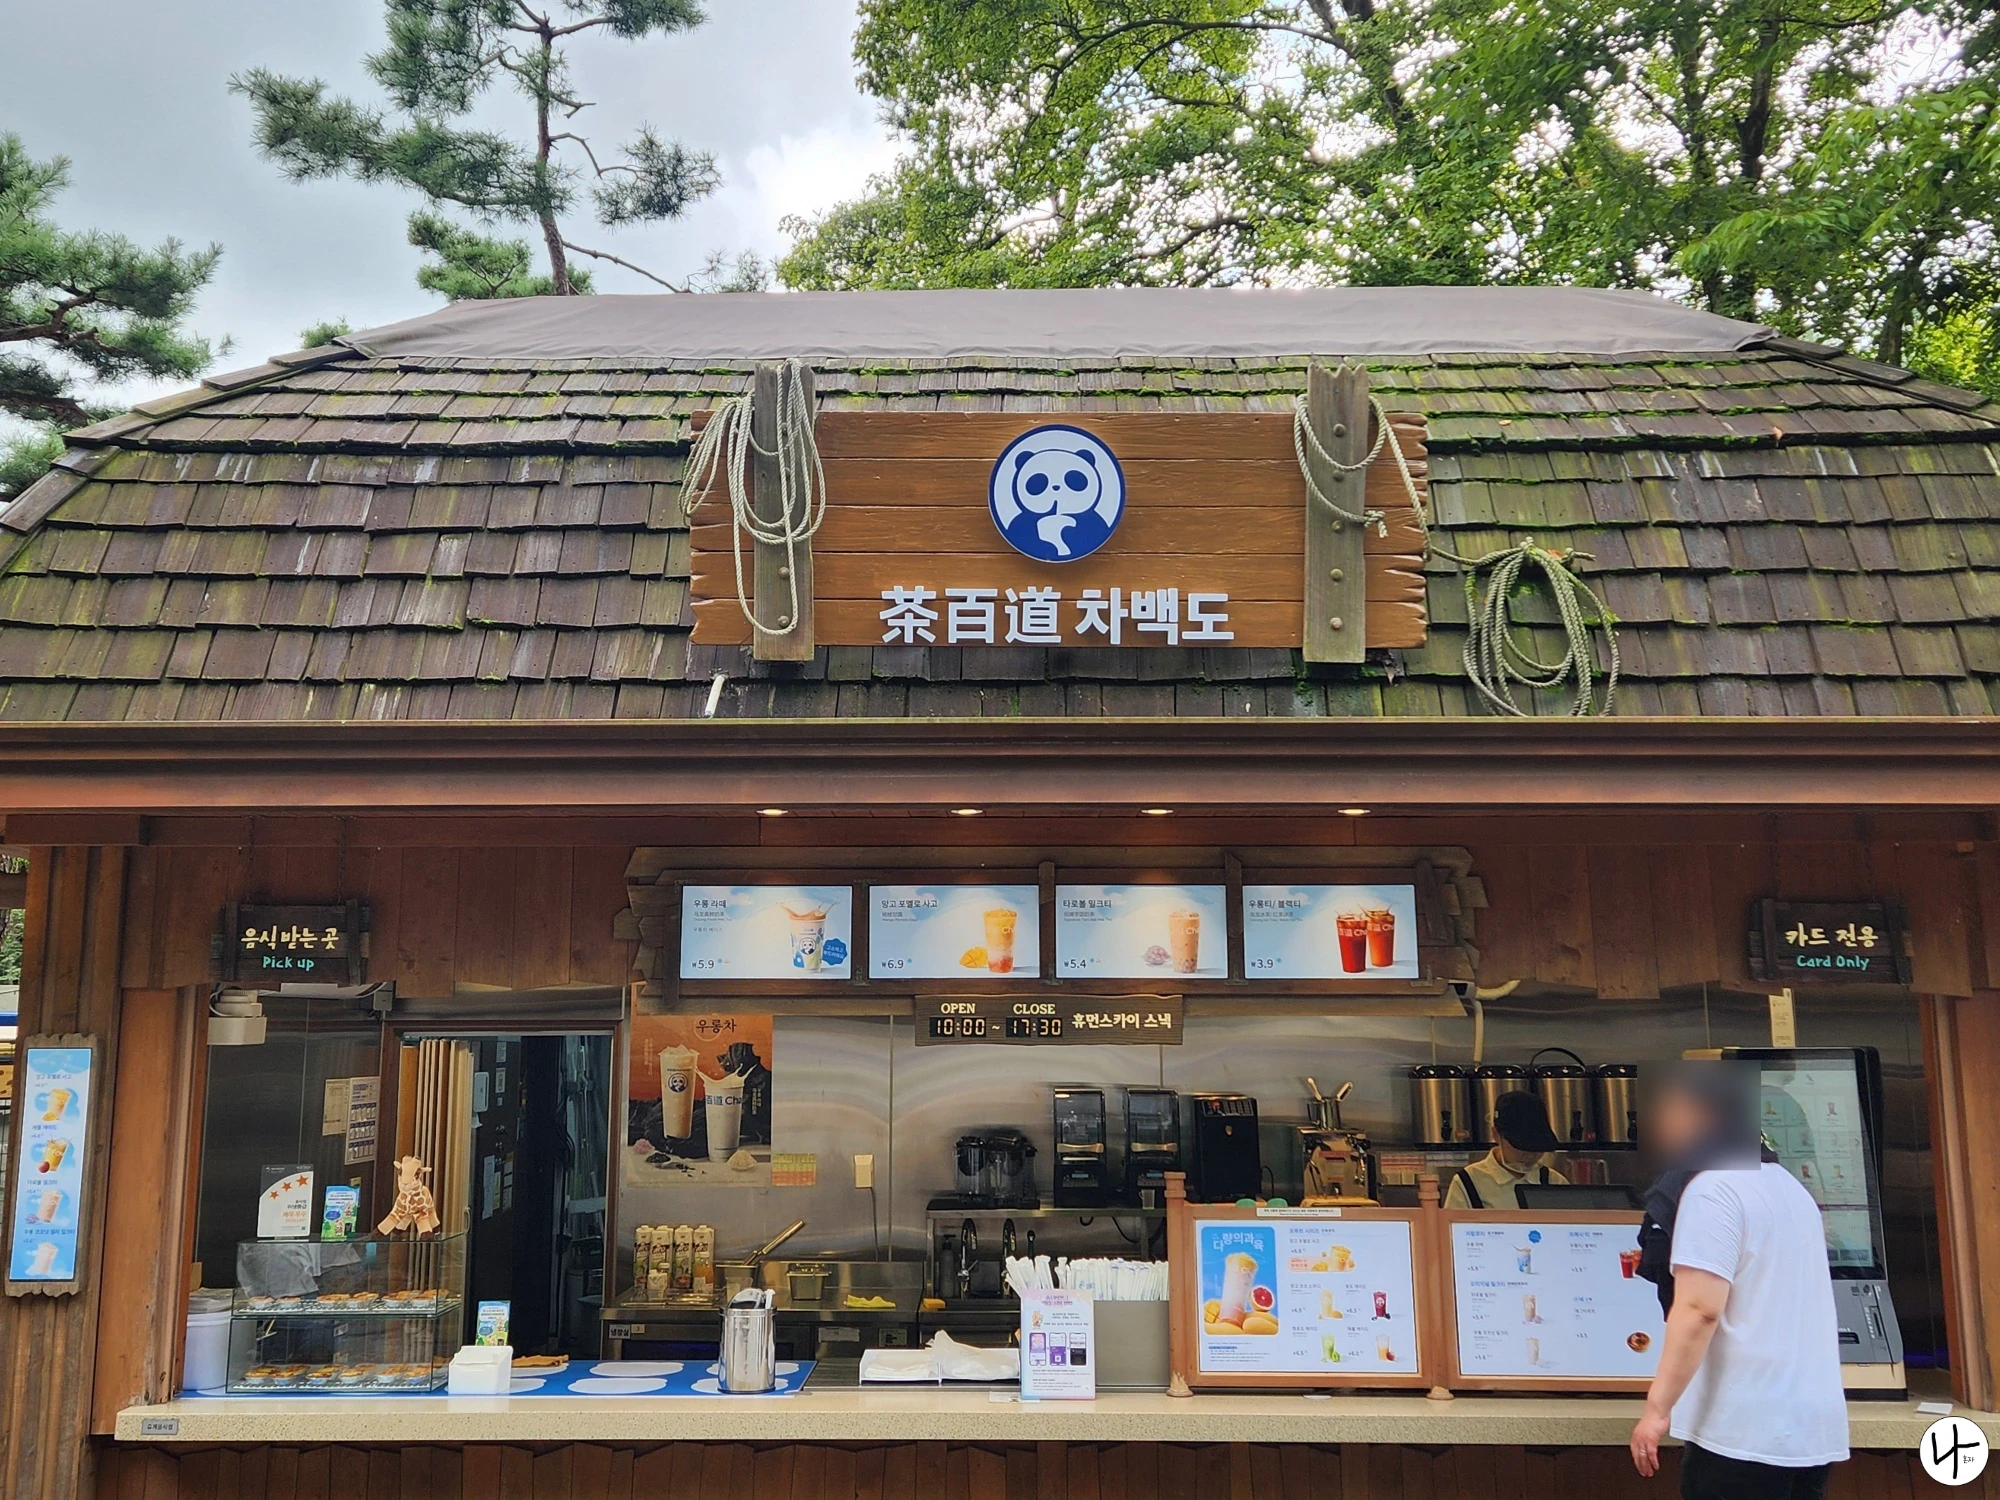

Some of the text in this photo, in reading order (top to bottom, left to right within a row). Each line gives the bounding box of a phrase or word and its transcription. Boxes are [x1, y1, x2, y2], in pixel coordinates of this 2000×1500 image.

[880, 585, 1235, 646] 茶百道 차백도
[923, 900, 938, 908] 사고
[241, 925, 339, 950] 음식 받는 곳
[1785, 922, 1878, 948] 카드 전용
[263, 956, 315, 972] Pick up
[1797, 955, 1869, 971] Card Only
[941, 1003, 1056, 1015] OPEN CLOSE
[697, 1019, 737, 1034] 우롱차
[936, 1019, 985, 1035] 10:00
[1012, 1019, 1061, 1035] 17:30
[1072, 1013, 1172, 1029] 휴먼스카이 스낵
